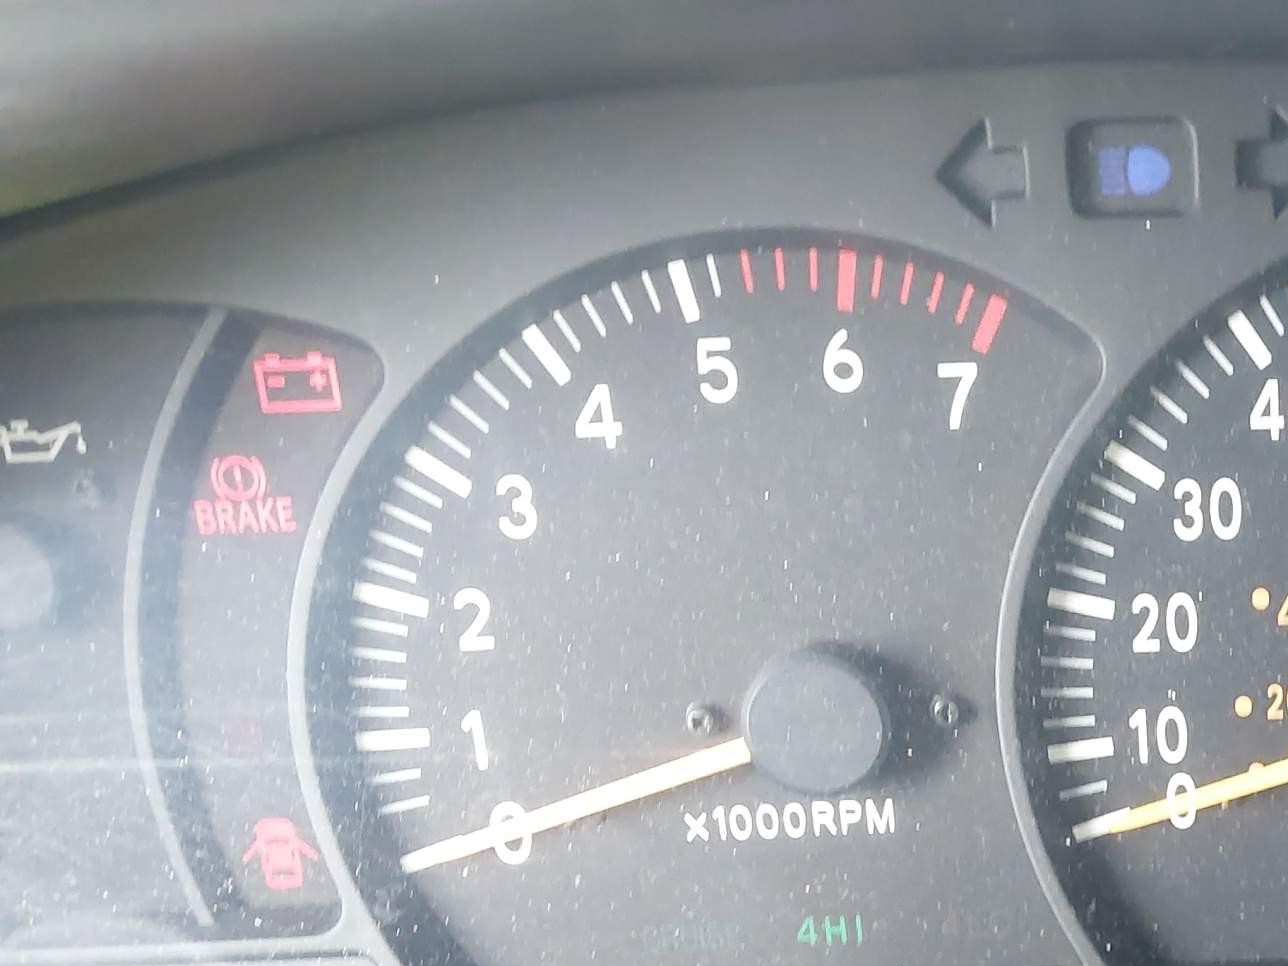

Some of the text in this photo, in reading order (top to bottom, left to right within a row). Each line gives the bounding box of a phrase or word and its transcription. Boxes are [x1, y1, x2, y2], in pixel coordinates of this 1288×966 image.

[697, 337, 737, 404] 5
[823, 329, 863, 393] 6
[576, 384, 622, 449] 4
[938, 362, 977, 429] 7
[193, 496, 296, 535] BRAKE
[497, 475, 537, 539] 3
[1174, 478, 1241, 541] 30
[454, 588, 494, 651] 2
[1132, 592, 1197, 652] 20
[461, 709, 487, 771] 1
[1129, 706, 1187, 764] 10
[1168, 772, 1198, 829] 0
[489, 801, 533, 864] 0
